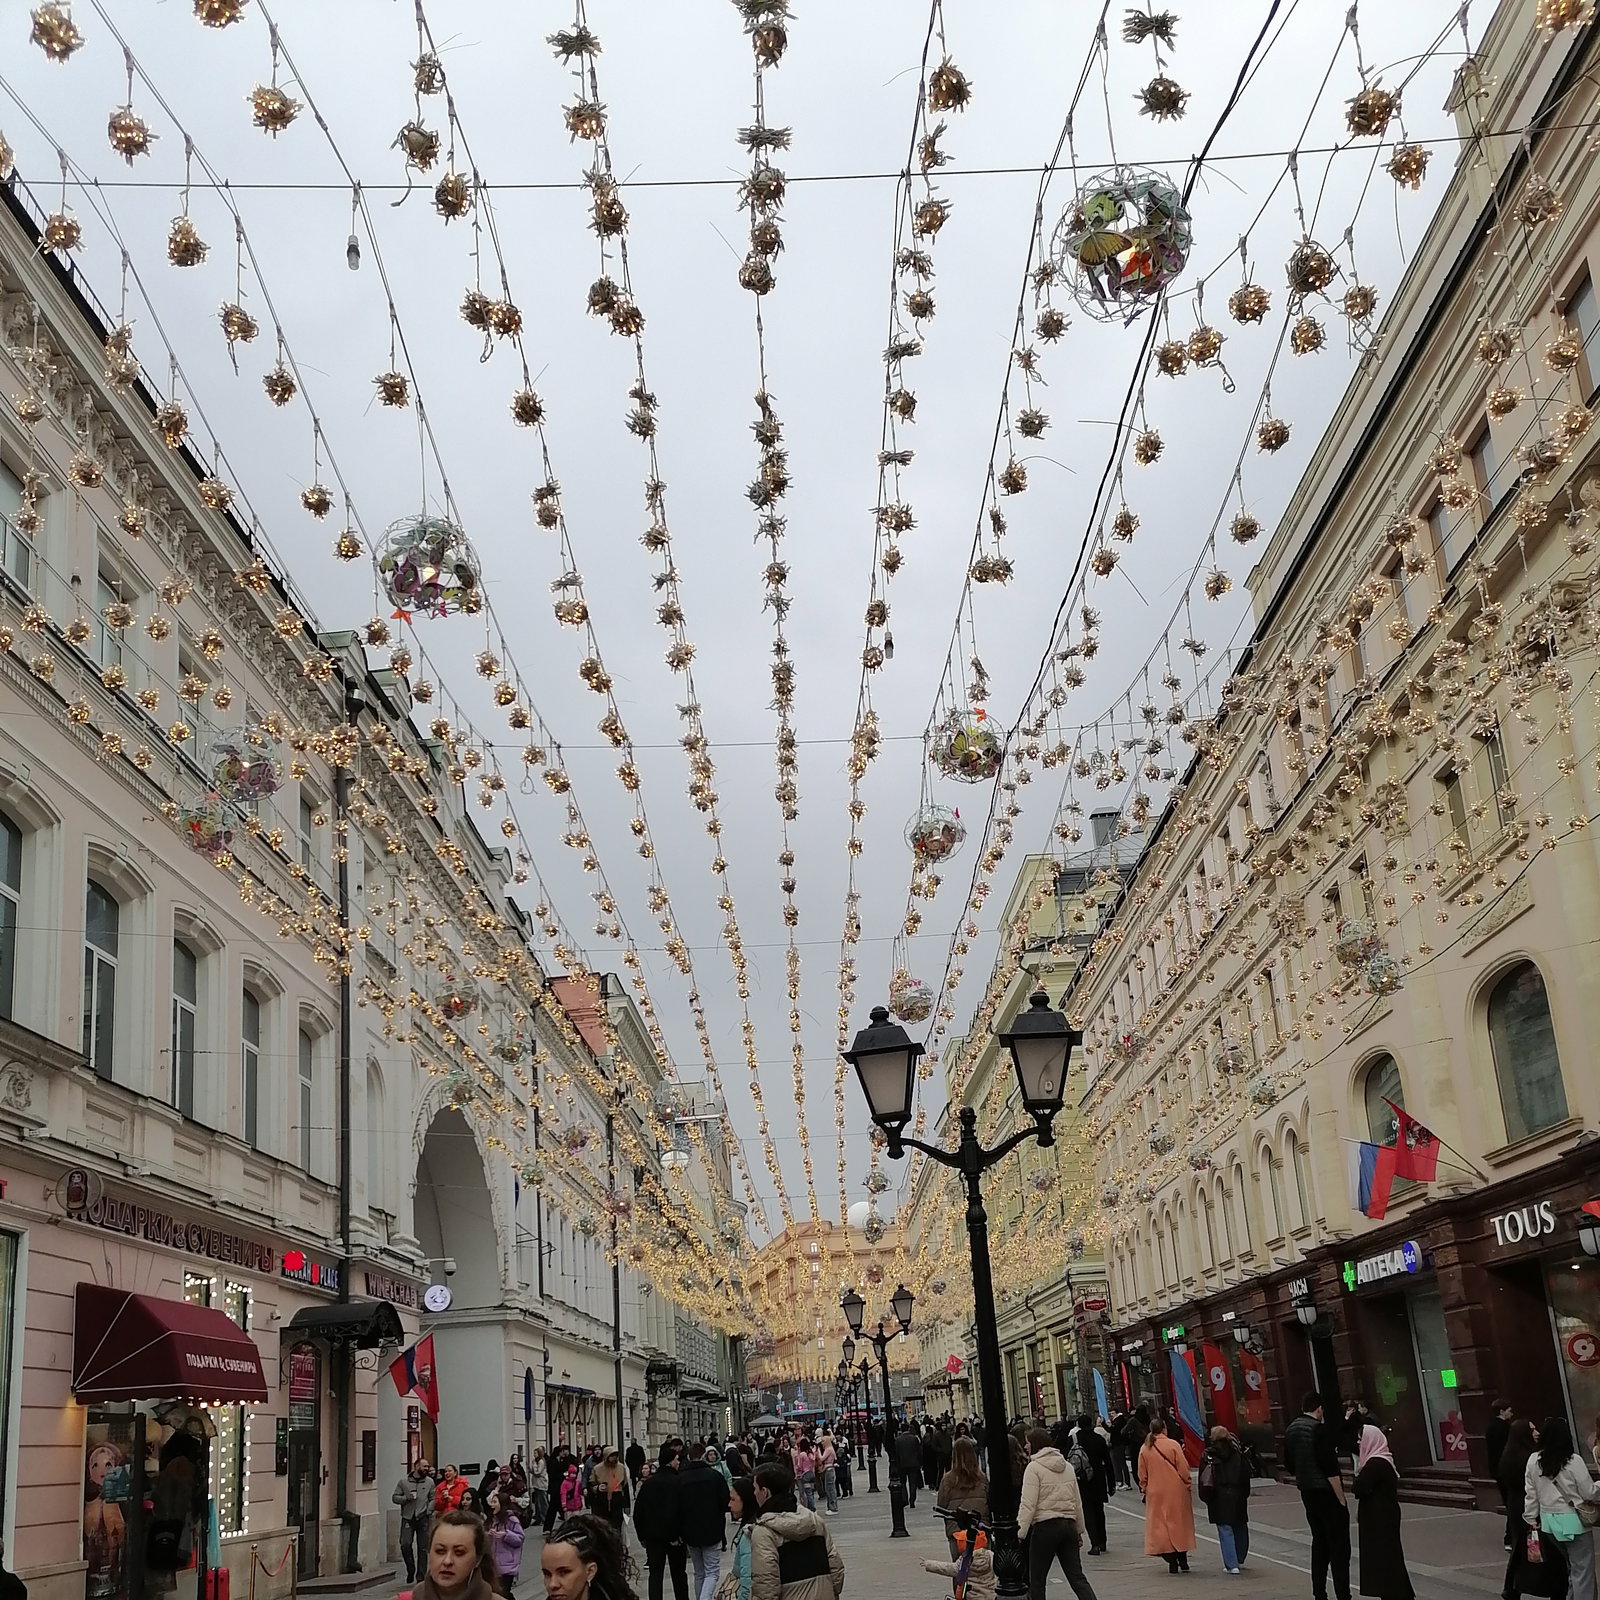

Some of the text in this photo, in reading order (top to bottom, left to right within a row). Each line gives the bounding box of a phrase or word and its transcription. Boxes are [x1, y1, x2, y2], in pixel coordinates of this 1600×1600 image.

[72, 1194, 174, 1243] ОДАРКИ
[187, 1222, 274, 1272] СУВЕНИРЫ
[1490, 1200, 1555, 1246] TOUS
[1356, 1249, 1408, 1285] АПТЕКА
[1287, 1277, 1309, 1298] ЧАСЫ
[185, 1353, 219, 1369] ПОДАРКИ
[225, 1358, 257, 1373] СУВЕНИРЫ
